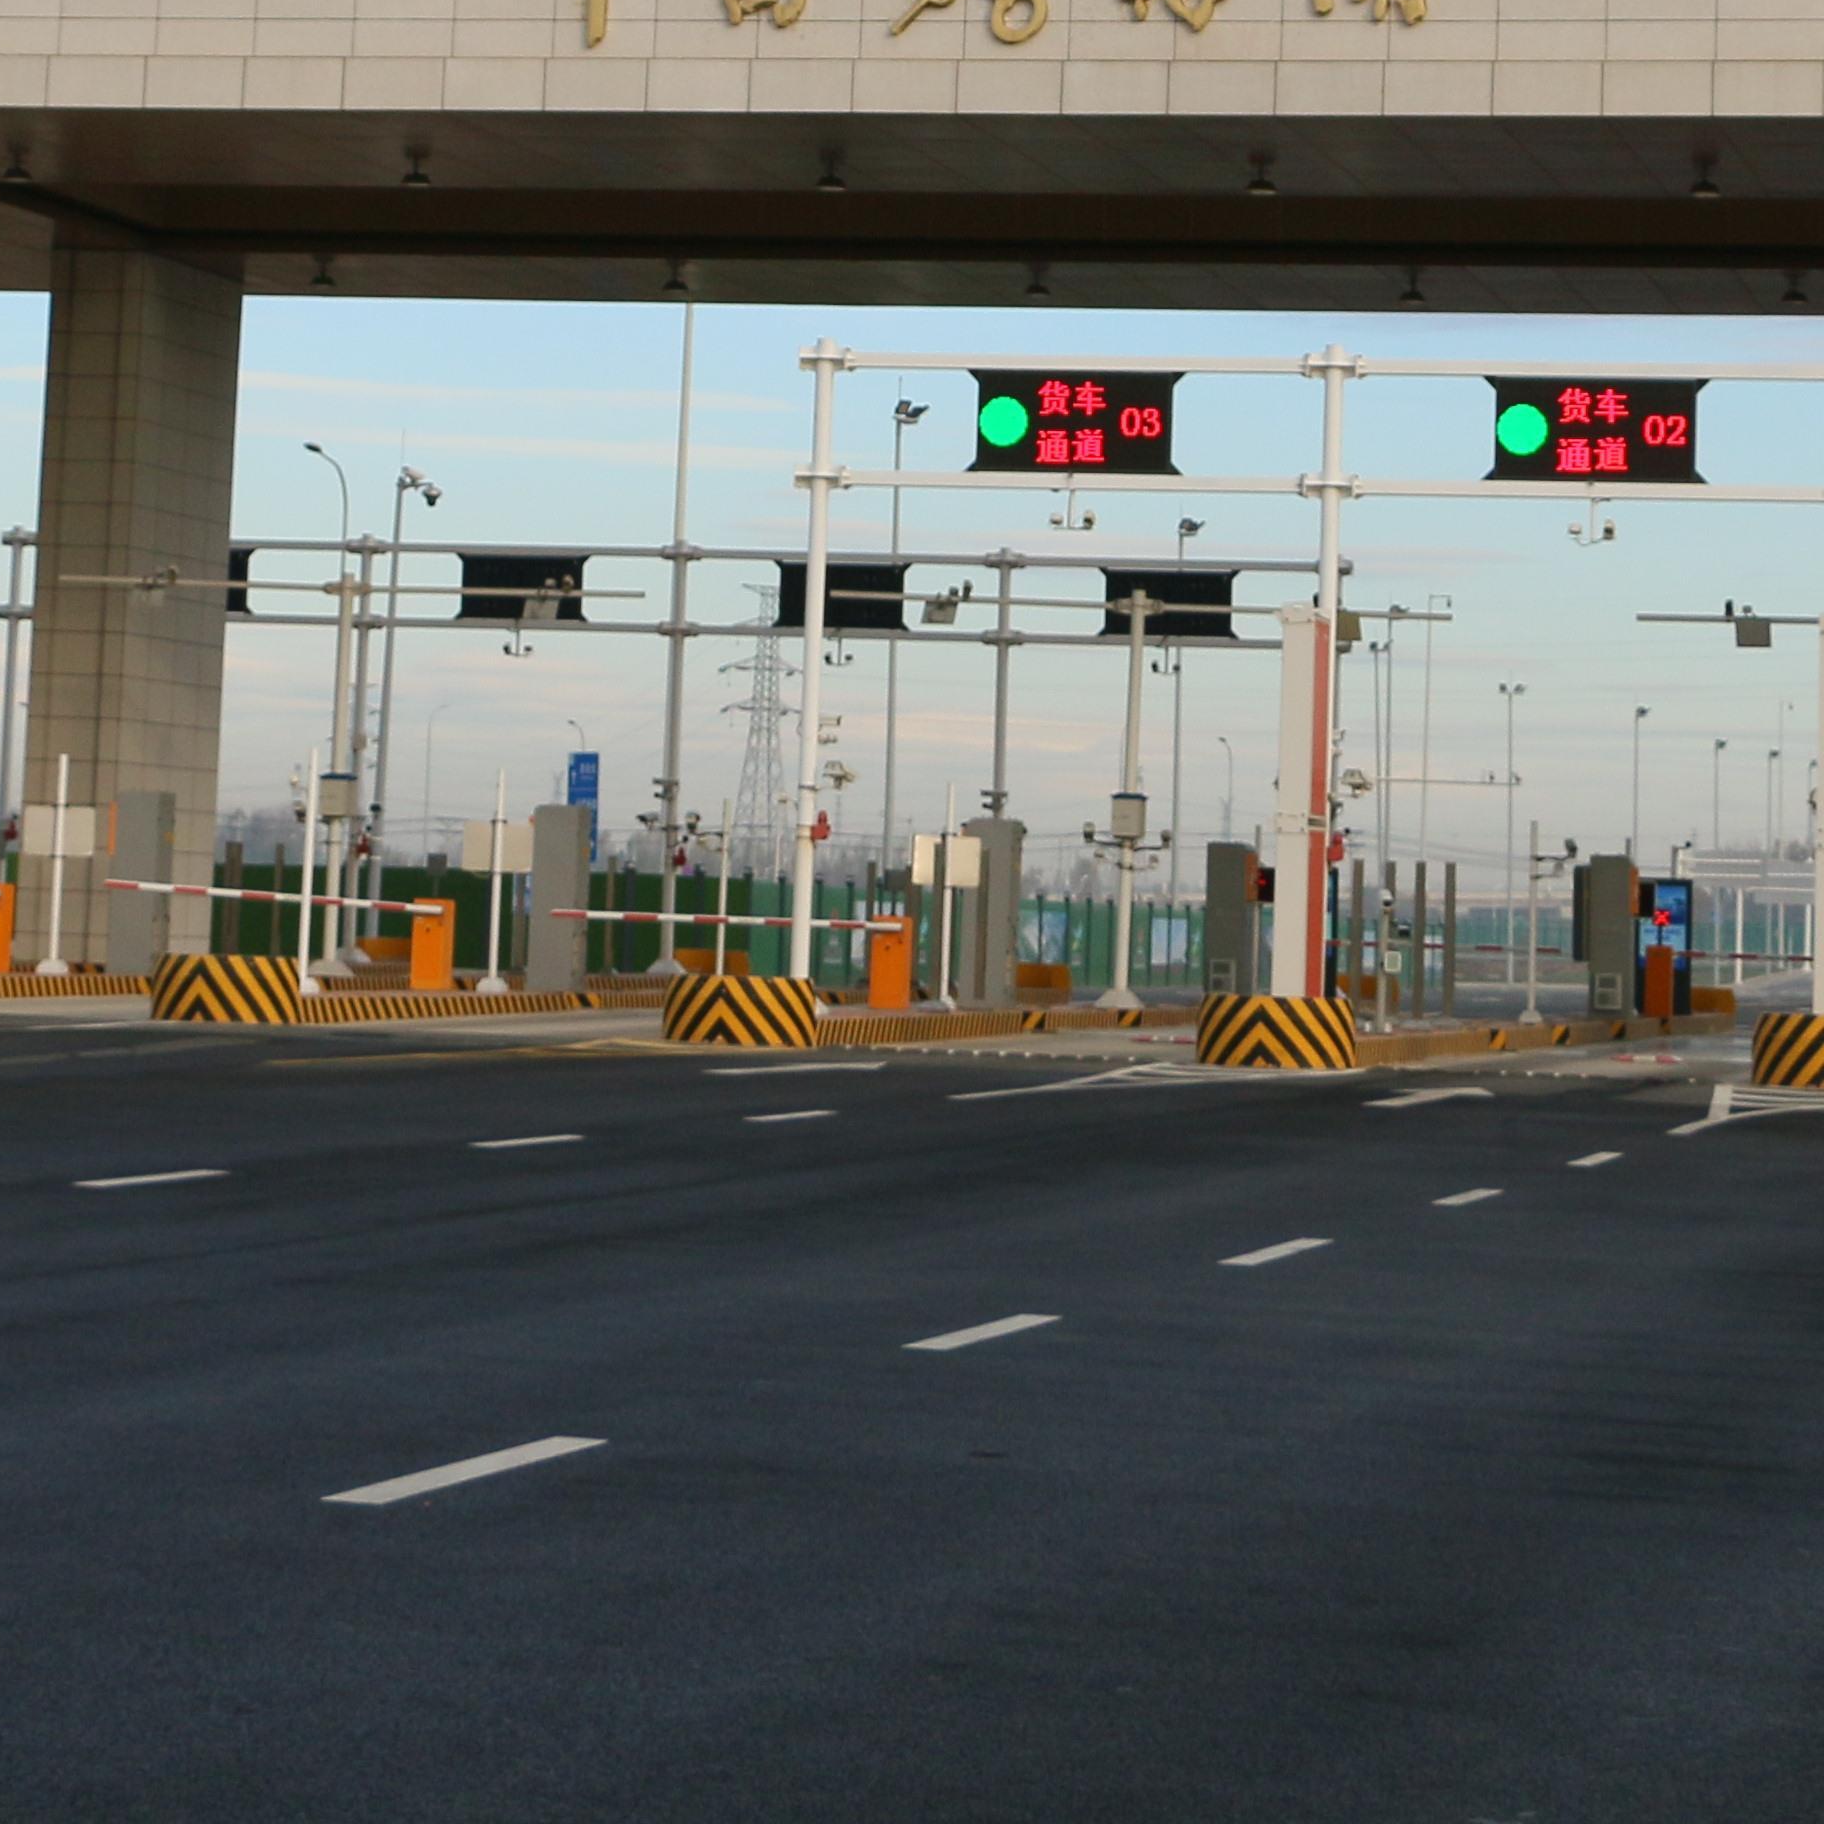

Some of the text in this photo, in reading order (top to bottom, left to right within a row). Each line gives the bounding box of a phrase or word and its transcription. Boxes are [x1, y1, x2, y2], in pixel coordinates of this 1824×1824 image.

[1038, 380, 1107, 416] 货车
[1557, 387, 1629, 424] 货车
[1119, 406, 1162, 438] 03
[1643, 414, 1688, 446] 02
[1036, 428, 1105, 463] 通道
[1555, 436, 1629, 472] 通道
